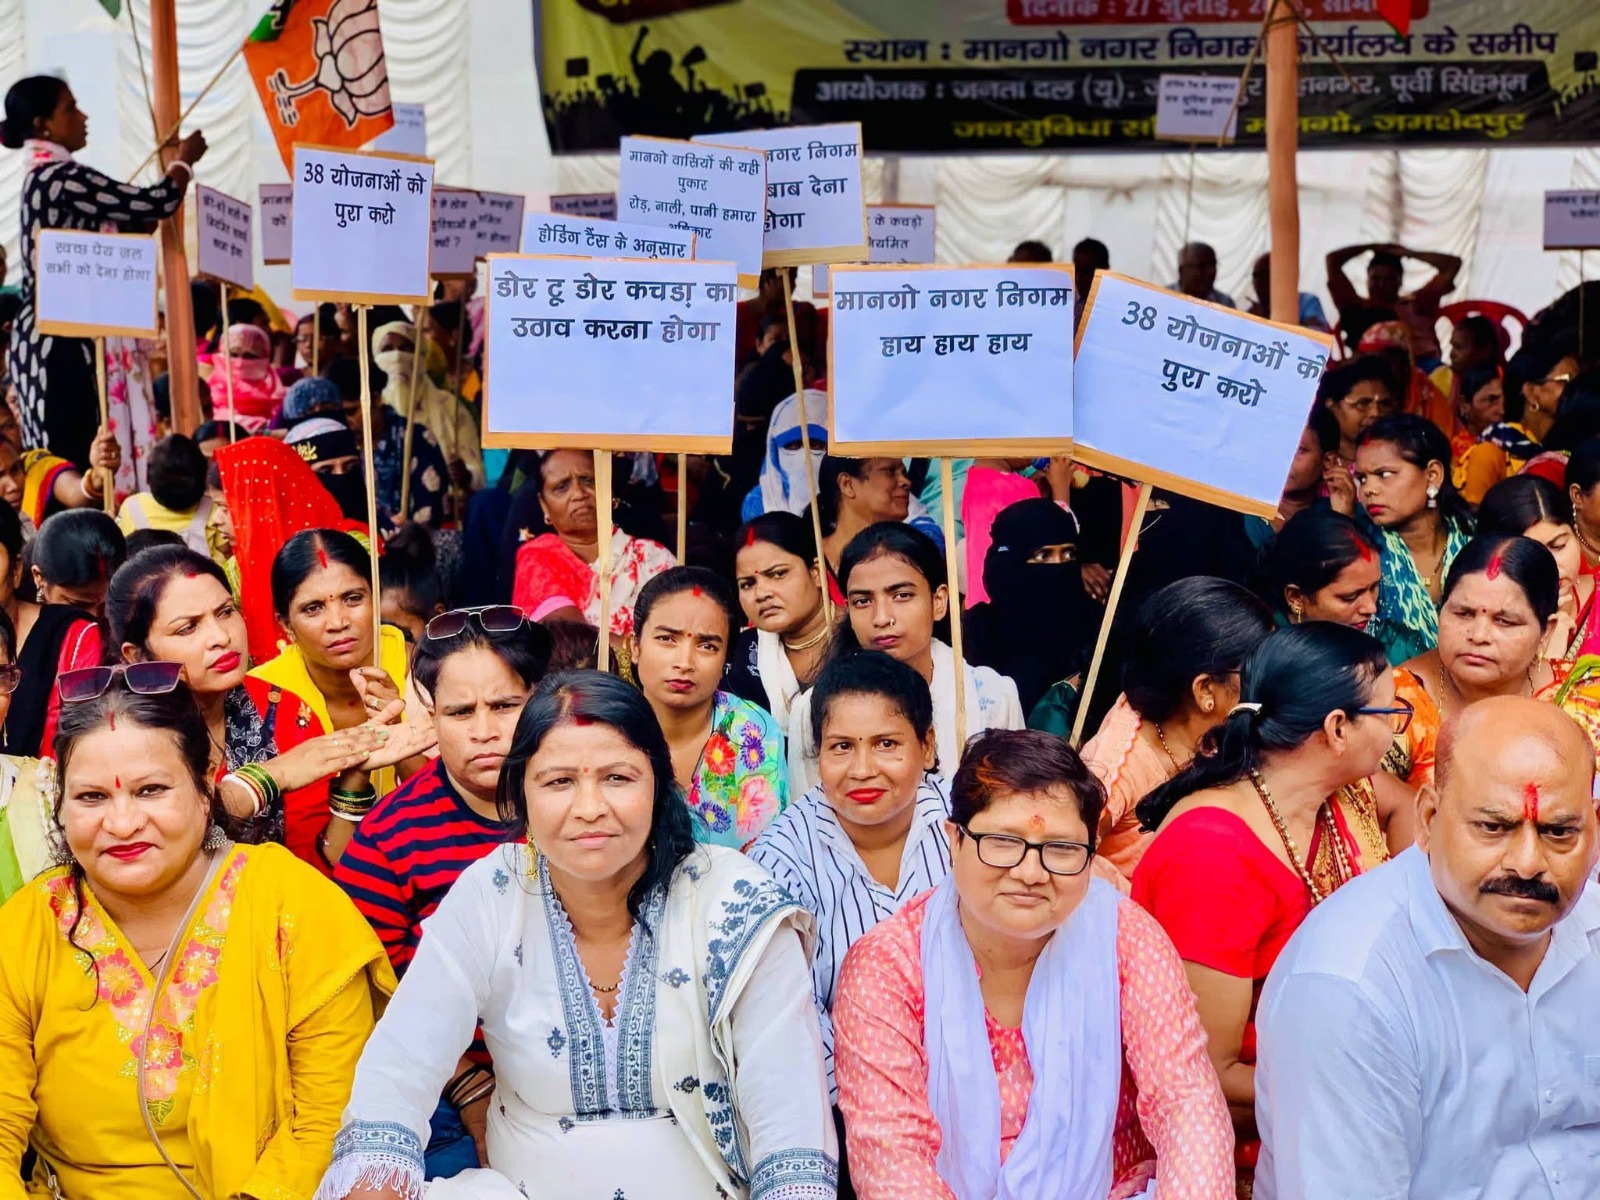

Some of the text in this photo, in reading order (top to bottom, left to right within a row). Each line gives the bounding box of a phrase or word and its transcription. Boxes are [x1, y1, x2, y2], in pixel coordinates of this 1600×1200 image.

[844, 39, 929, 62] स्थान
[941, 42, 951, 60] :
[963, 29, 1069, 61] मानगो
[1080, 37, 1160, 60] नगर
[1422, 26, 1458, 55] के
[1467, 23, 1558, 55] समीप
[815, 74, 928, 101] आयोजक
[951, 80, 1027, 100] जनता
[1033, 80, 1075, 100] दल
[1390, 67, 1433, 103] पूर्वी
[1440, 67, 1529, 103] सिंहभूम
[953, 113, 1112, 146] जनसुविधा
[1372, 108, 1527, 139] जमशेदपुर
[629, 150, 760, 175] मानगो वासियों की यही
[808, 141, 859, 160] निगम
[304, 162, 427, 194] 38 योजनाओं को
[677, 177, 708, 193] पुकार
[767, 175, 848, 198] बाब देना
[334, 202, 396, 228] पुरा करो
[655, 199, 685, 217] नाली,
[690, 203, 718, 218] पानी
[722, 208, 757, 223] हमारा
[875, 213, 885, 226] के
[92, 241, 114, 256] पेय
[120, 246, 144, 260] जल
[538, 223, 581, 245] होर्डिंग
[614, 231, 628, 250] के
[633, 238, 687, 259] अनुसार
[46, 260, 151, 281] सभी को देना होगा
[494, 270, 538, 299] डोर
[547, 278, 565, 307] टू
[573, 273, 617, 301] डोर
[705, 282, 737, 303] का
[834, 281, 1072, 311] मानगो नगर निगम
[511, 314, 721, 343] उठाव करना होगा
[1121, 300, 1328, 384] 38 योजनाओं को
[879, 333, 1033, 358] हाय हाय हाय
[1161, 358, 1267, 407] पुरा करो
